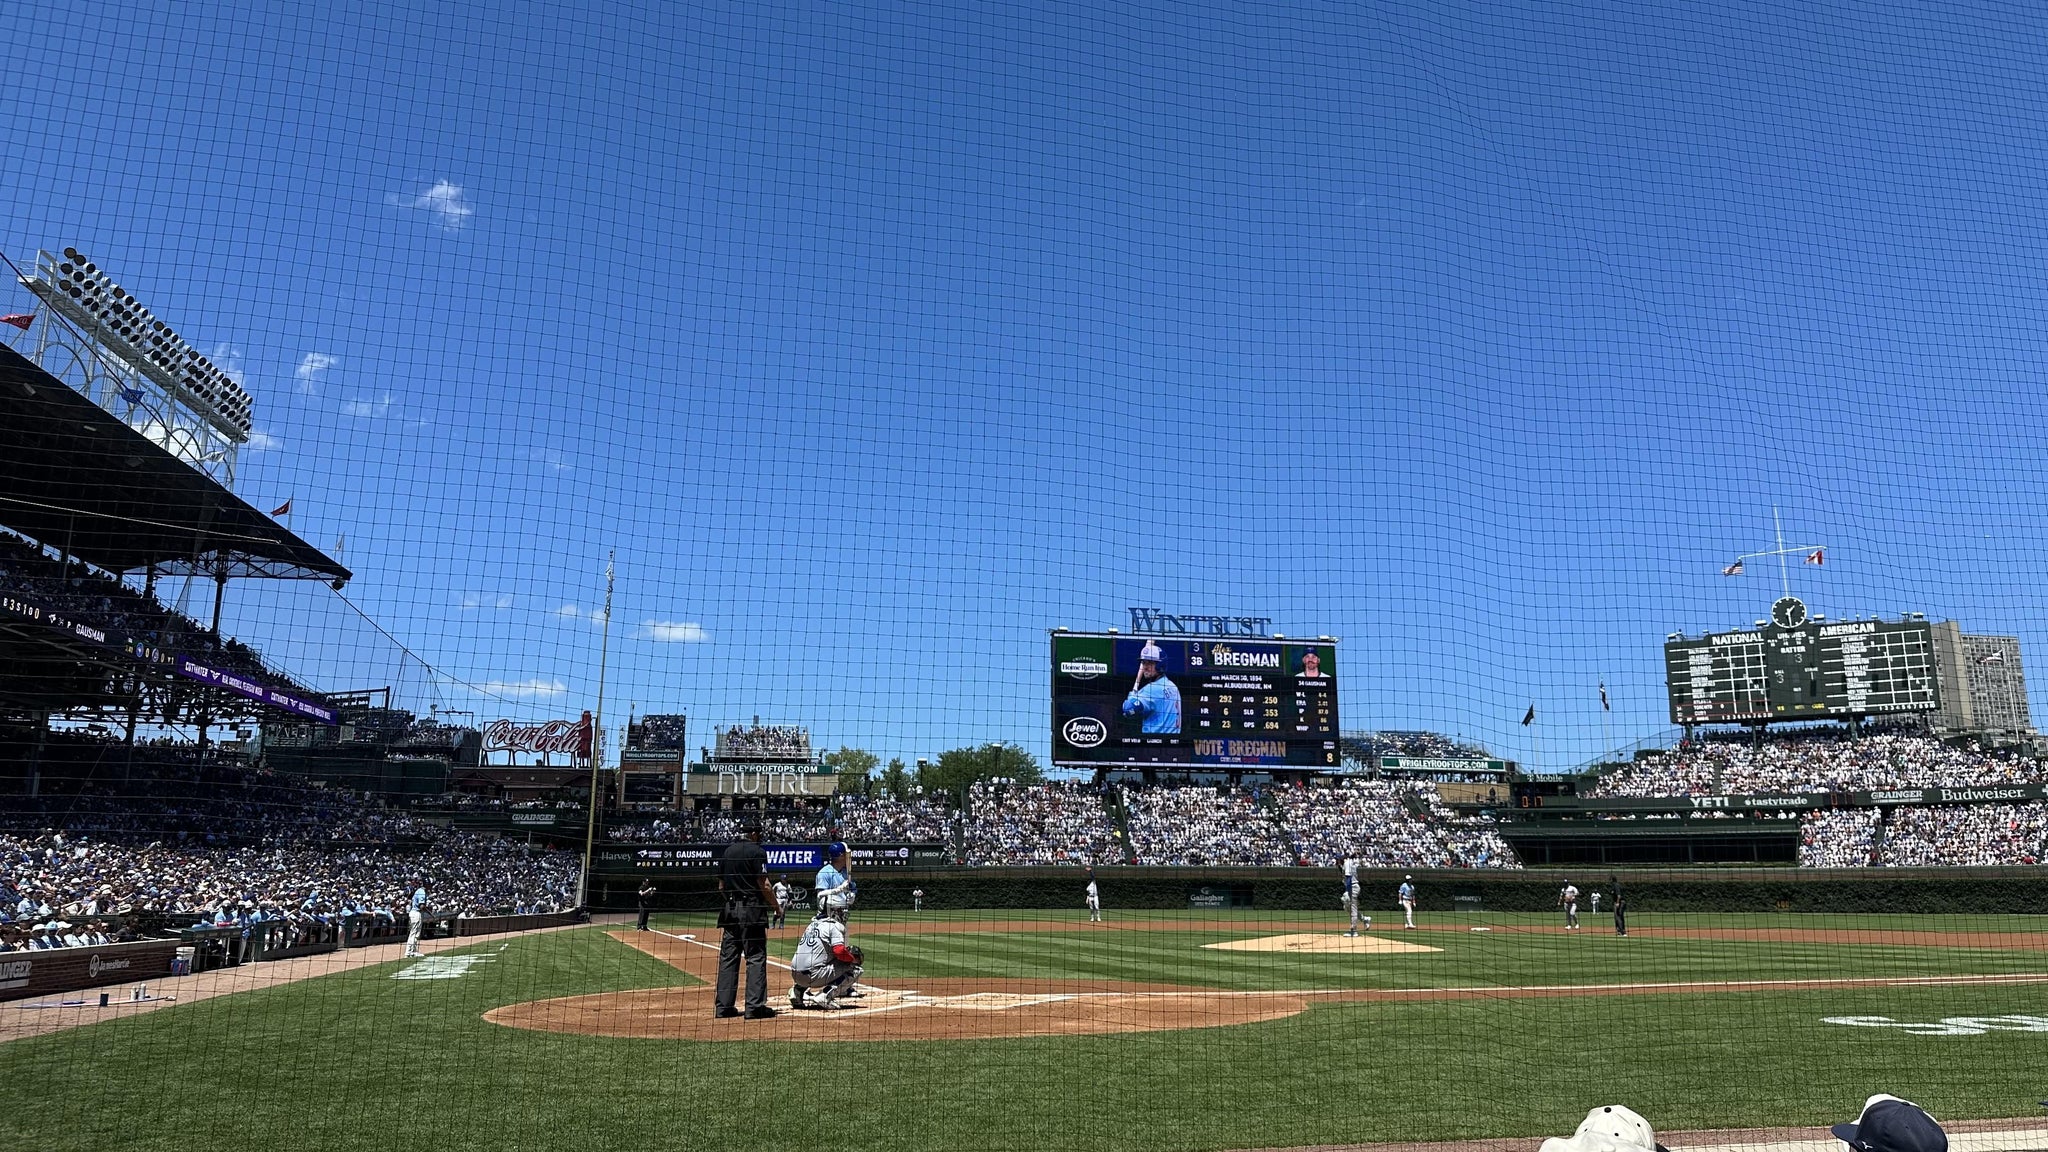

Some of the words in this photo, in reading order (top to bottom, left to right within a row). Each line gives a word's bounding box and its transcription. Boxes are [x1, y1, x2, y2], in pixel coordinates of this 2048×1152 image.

[9, 599, 15, 610] 3
[1128, 607, 1272, 637] WINTRUST
[75, 623, 105, 643] GAUSMAN
[1819, 622, 1875, 636] AMERICAN
[1712, 632, 1764, 645] NATIONAL
[1193, 643, 1200, 652] 3
[1211, 643, 1232, 655] Alex
[1191, 657, 1203, 665] 3B
[1214, 653, 1280, 667] BREGMAN
[1795, 653, 1802, 663] 3
[1062, 663, 1080, 671] Home
[1219, 695, 1232, 703] 292
[1263, 696, 1278, 704] .250
[1224, 708, 1229, 716] 6
[1263, 709, 1278, 717] .353
[1069, 722, 1099, 733] Jewel
[482, 719, 589, 754] Coca-Cola
[1194, 740, 1225, 756] VOTE
[1228, 741, 1286, 757] BREGMAN
[1327, 753, 1333, 762] 8
[709, 764, 818, 773] WRIGLEYROOFTOPS.COM
[1398, 759, 1489, 769] WRIGLEYROOFTOPS.COM
[1536, 774, 1563, 782] Mobile
[1871, 790, 1923, 799] GRAINGER
[1941, 787, 2024, 801] Budweiser
[1690, 797, 1729, 808] YETI
[1752, 797, 1808, 807] tastytrade
[601, 851, 632, 862] Harvey
[676, 850, 712, 858] GAUSMAN
[1191, 894, 1224, 902] Gallagher
